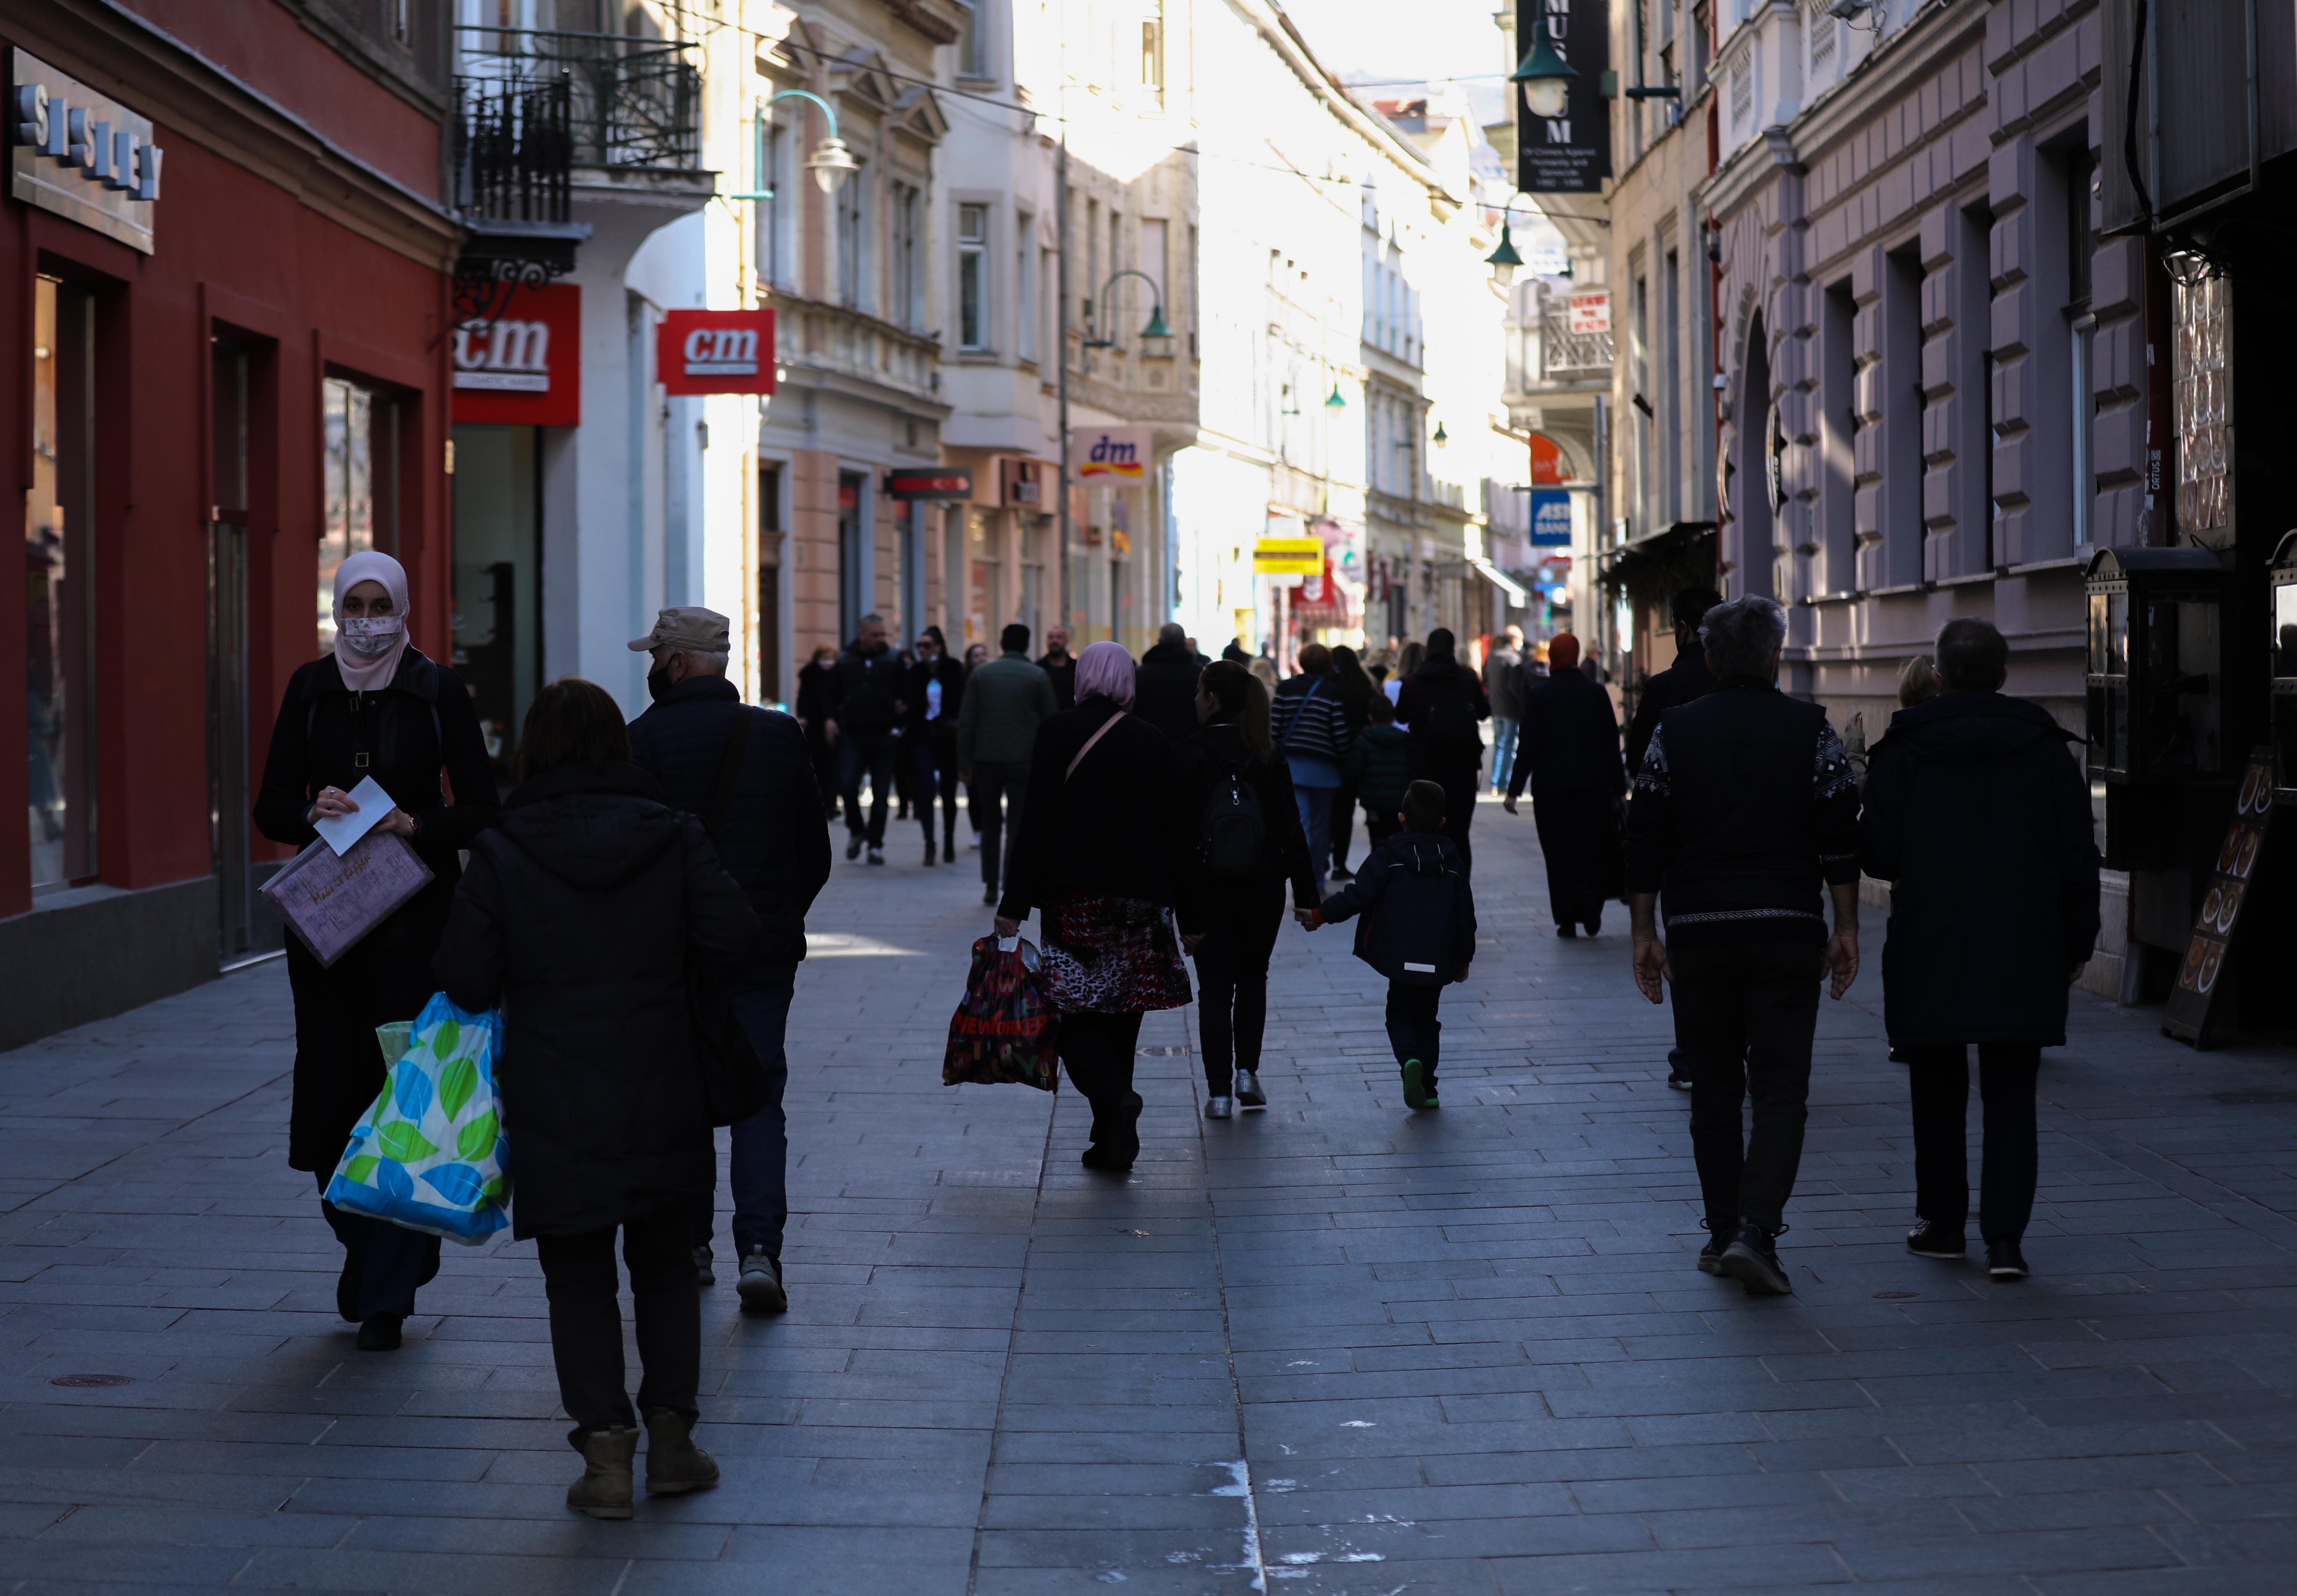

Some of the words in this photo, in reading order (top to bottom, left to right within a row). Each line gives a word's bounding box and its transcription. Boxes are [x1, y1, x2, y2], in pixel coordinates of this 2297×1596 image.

[1545, 0, 1571, 143] MUSM
[20, 84, 163, 201] SISLEY
[453, 319, 549, 372] cm
[684, 329, 759, 362] cm
[1090, 435, 1136, 463] dm
[311, 885, 335, 905] Make
